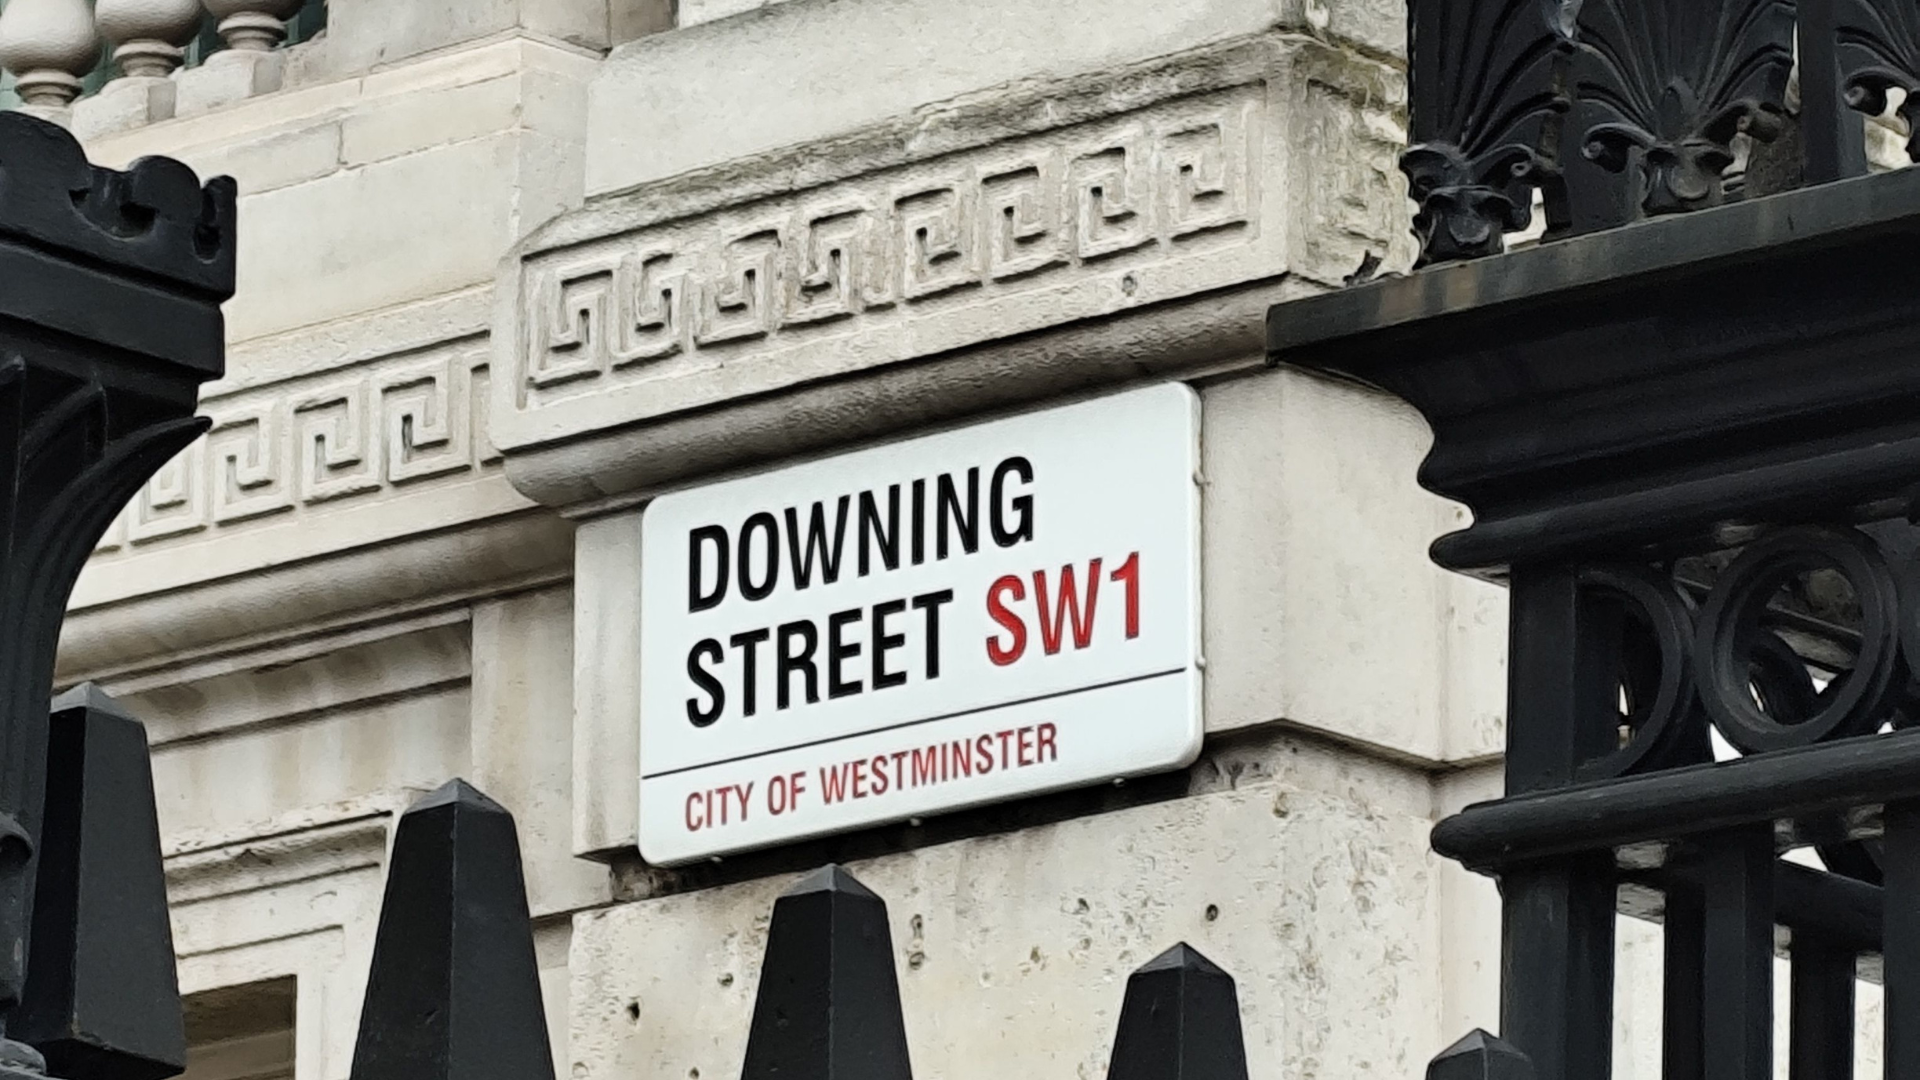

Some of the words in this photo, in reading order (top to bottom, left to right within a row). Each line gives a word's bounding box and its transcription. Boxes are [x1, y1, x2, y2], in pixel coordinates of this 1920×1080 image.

[688, 456, 1034, 614] DOWNING
[686, 588, 954, 728] STREET
[986, 551, 1140, 668] SW1
[685, 782, 754, 832] CITY
[767, 770, 807, 817] OF
[820, 722, 1057, 805] WESTMINSTER
